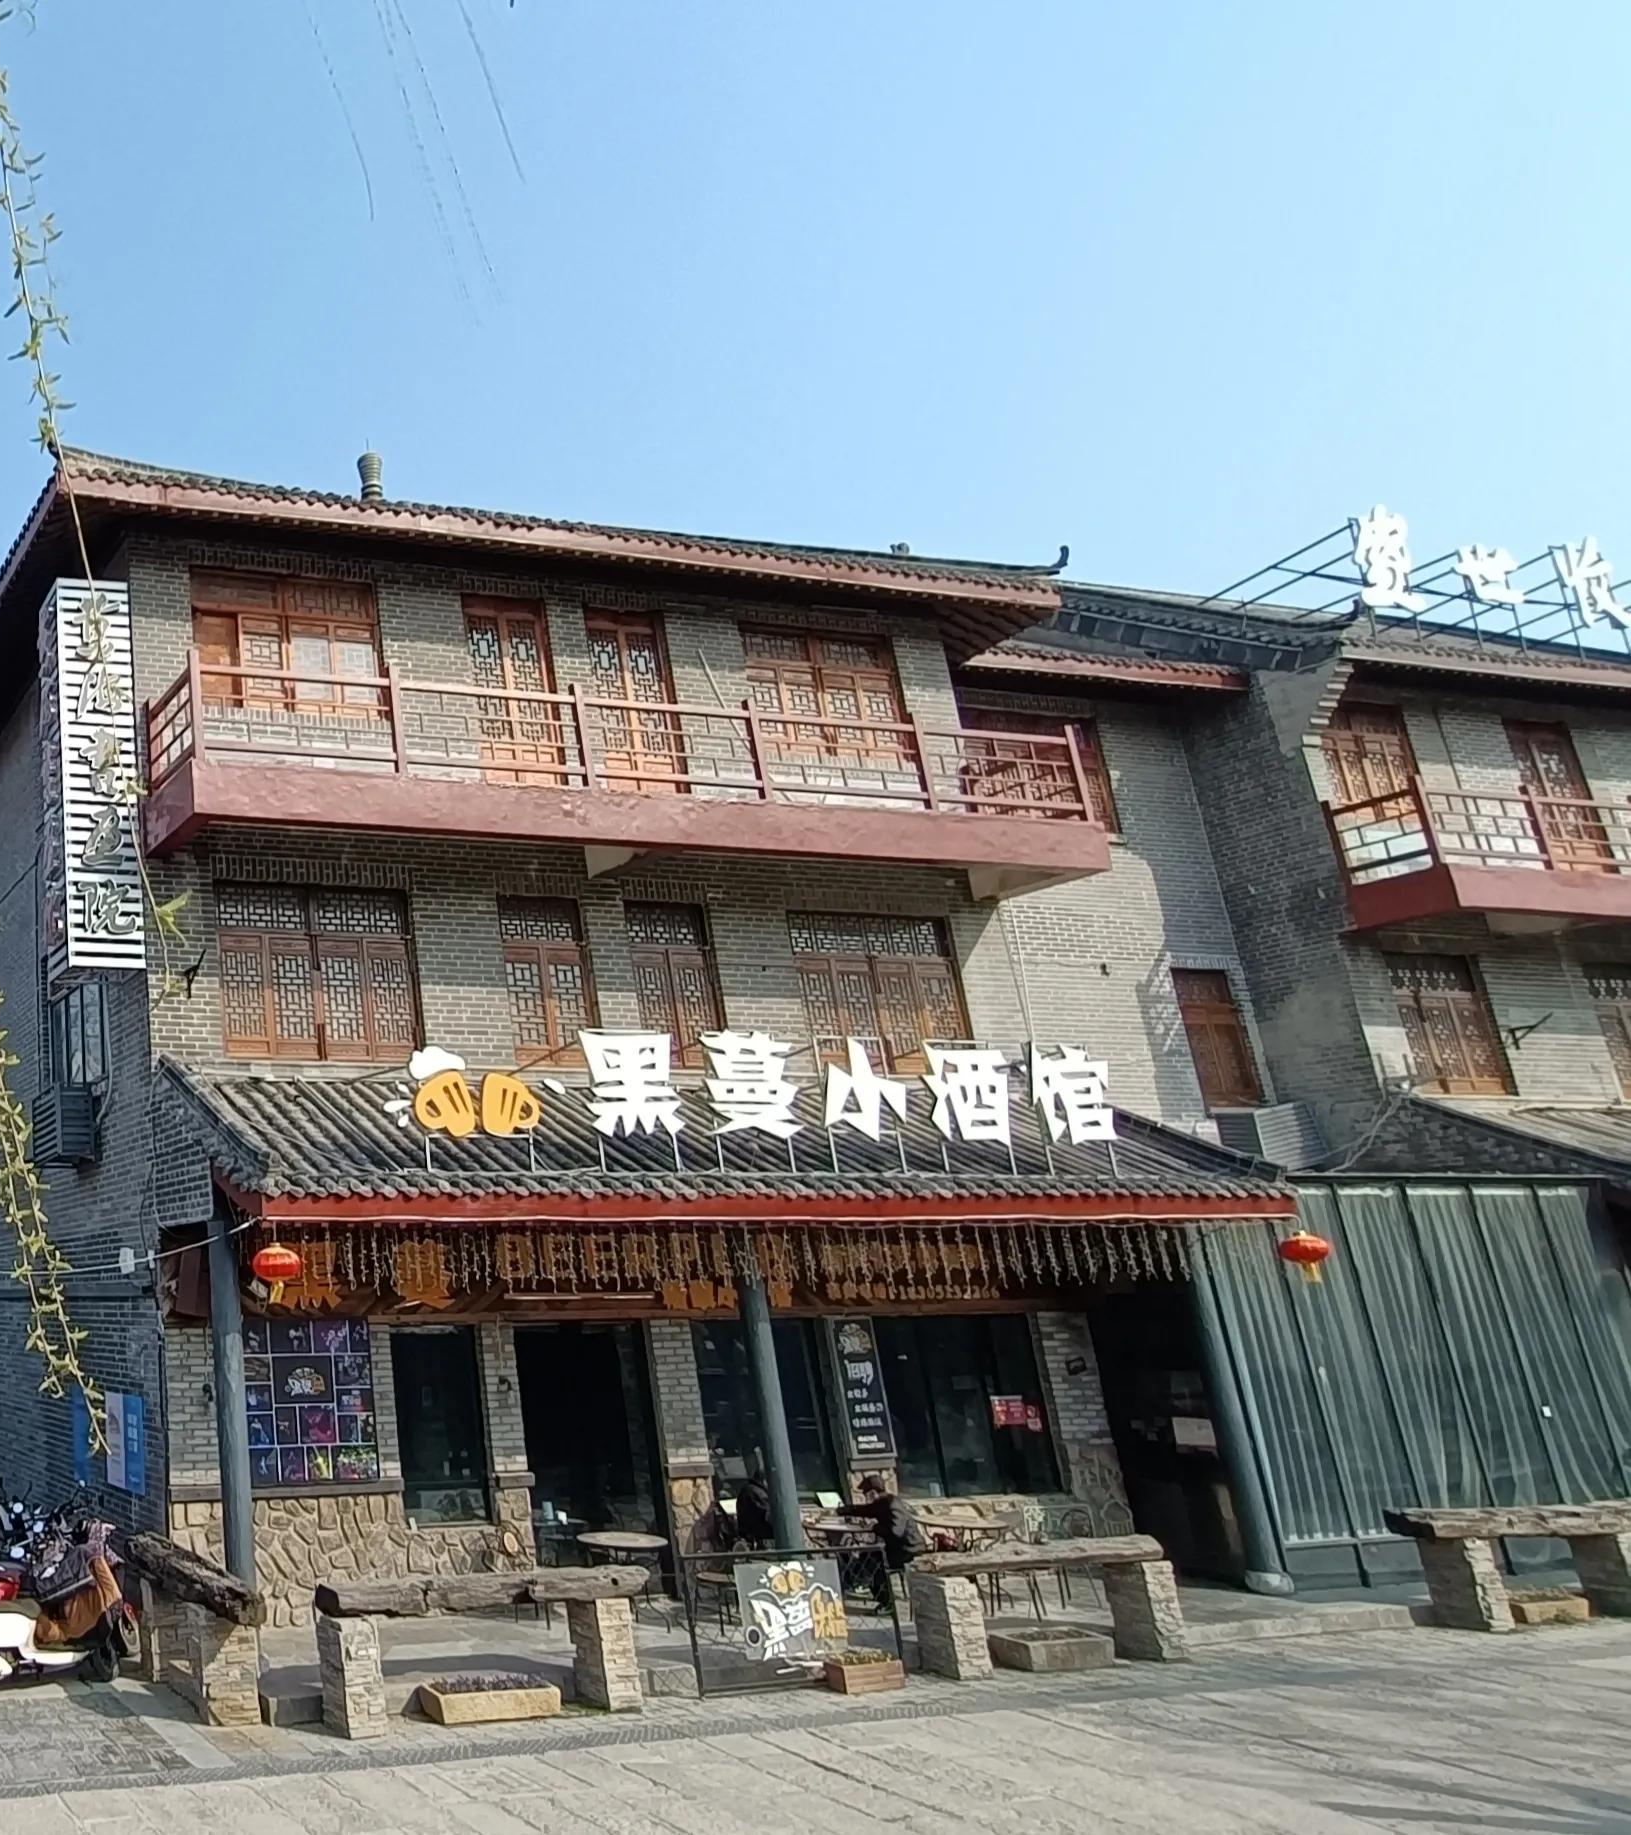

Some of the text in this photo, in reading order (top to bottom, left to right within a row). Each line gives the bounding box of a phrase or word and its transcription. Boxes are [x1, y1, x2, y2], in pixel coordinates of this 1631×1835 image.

[578, 1028, 1118, 1146] 黑蔓小酒馆
